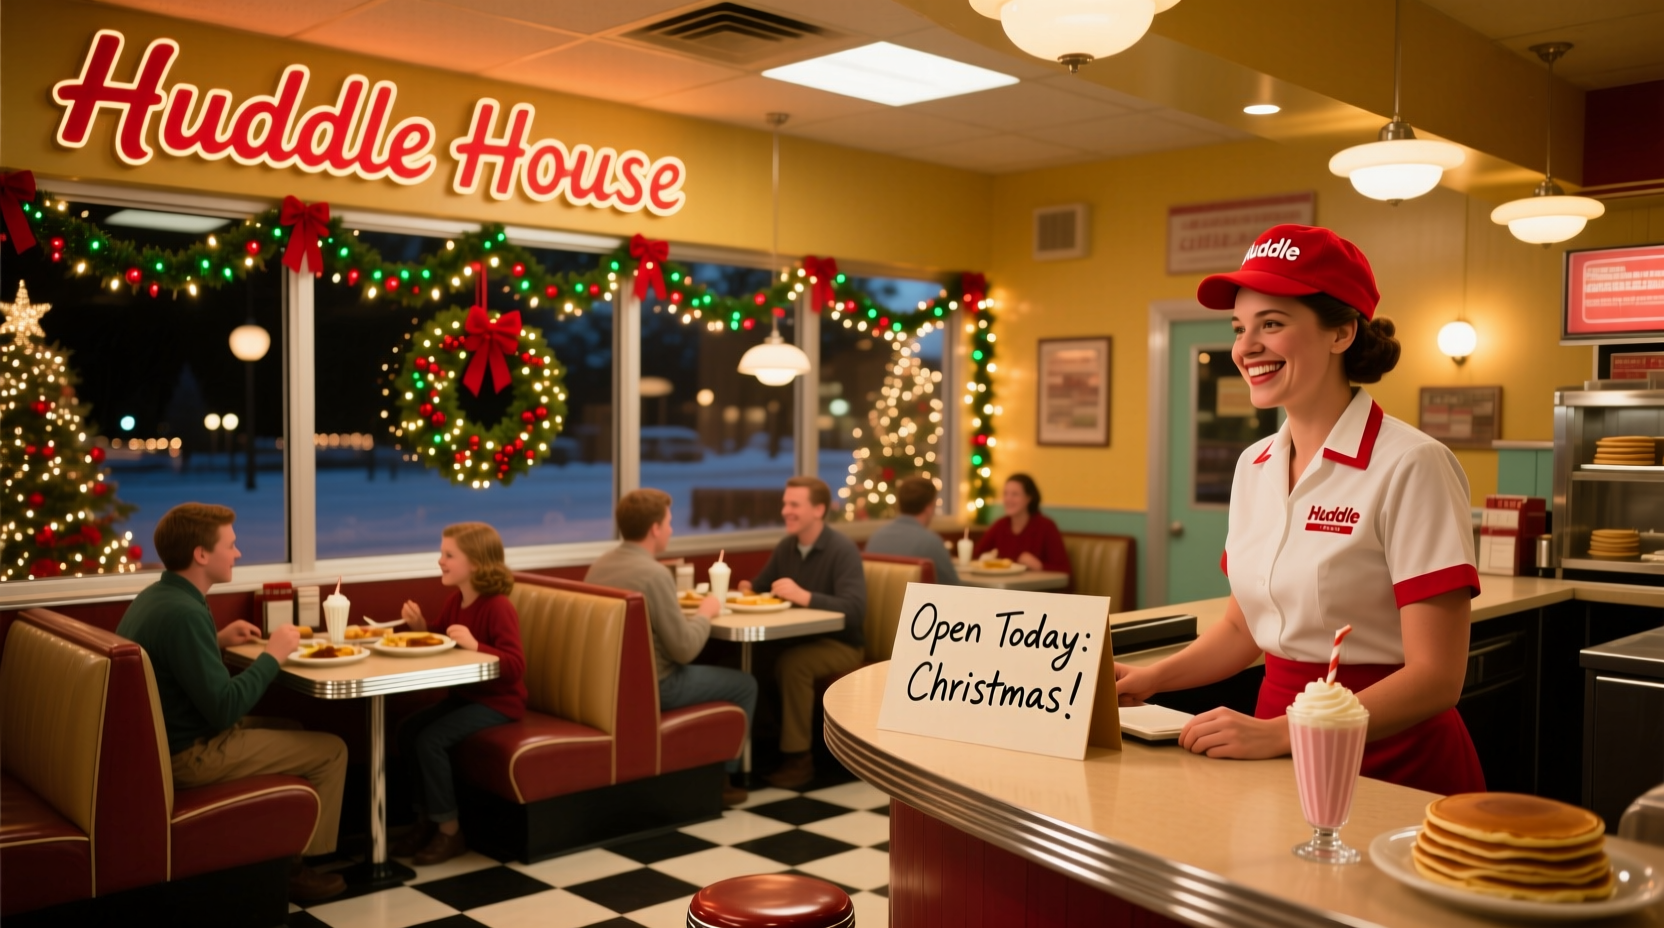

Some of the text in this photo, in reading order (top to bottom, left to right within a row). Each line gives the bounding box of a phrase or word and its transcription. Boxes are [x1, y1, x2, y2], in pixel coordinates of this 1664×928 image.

[53, 29, 686, 216] Huddle House
[1307, 504, 1361, 524] Huddle
[911, 602, 1091, 671] Open Today:
[907, 661, 1083, 720] Christmas!
